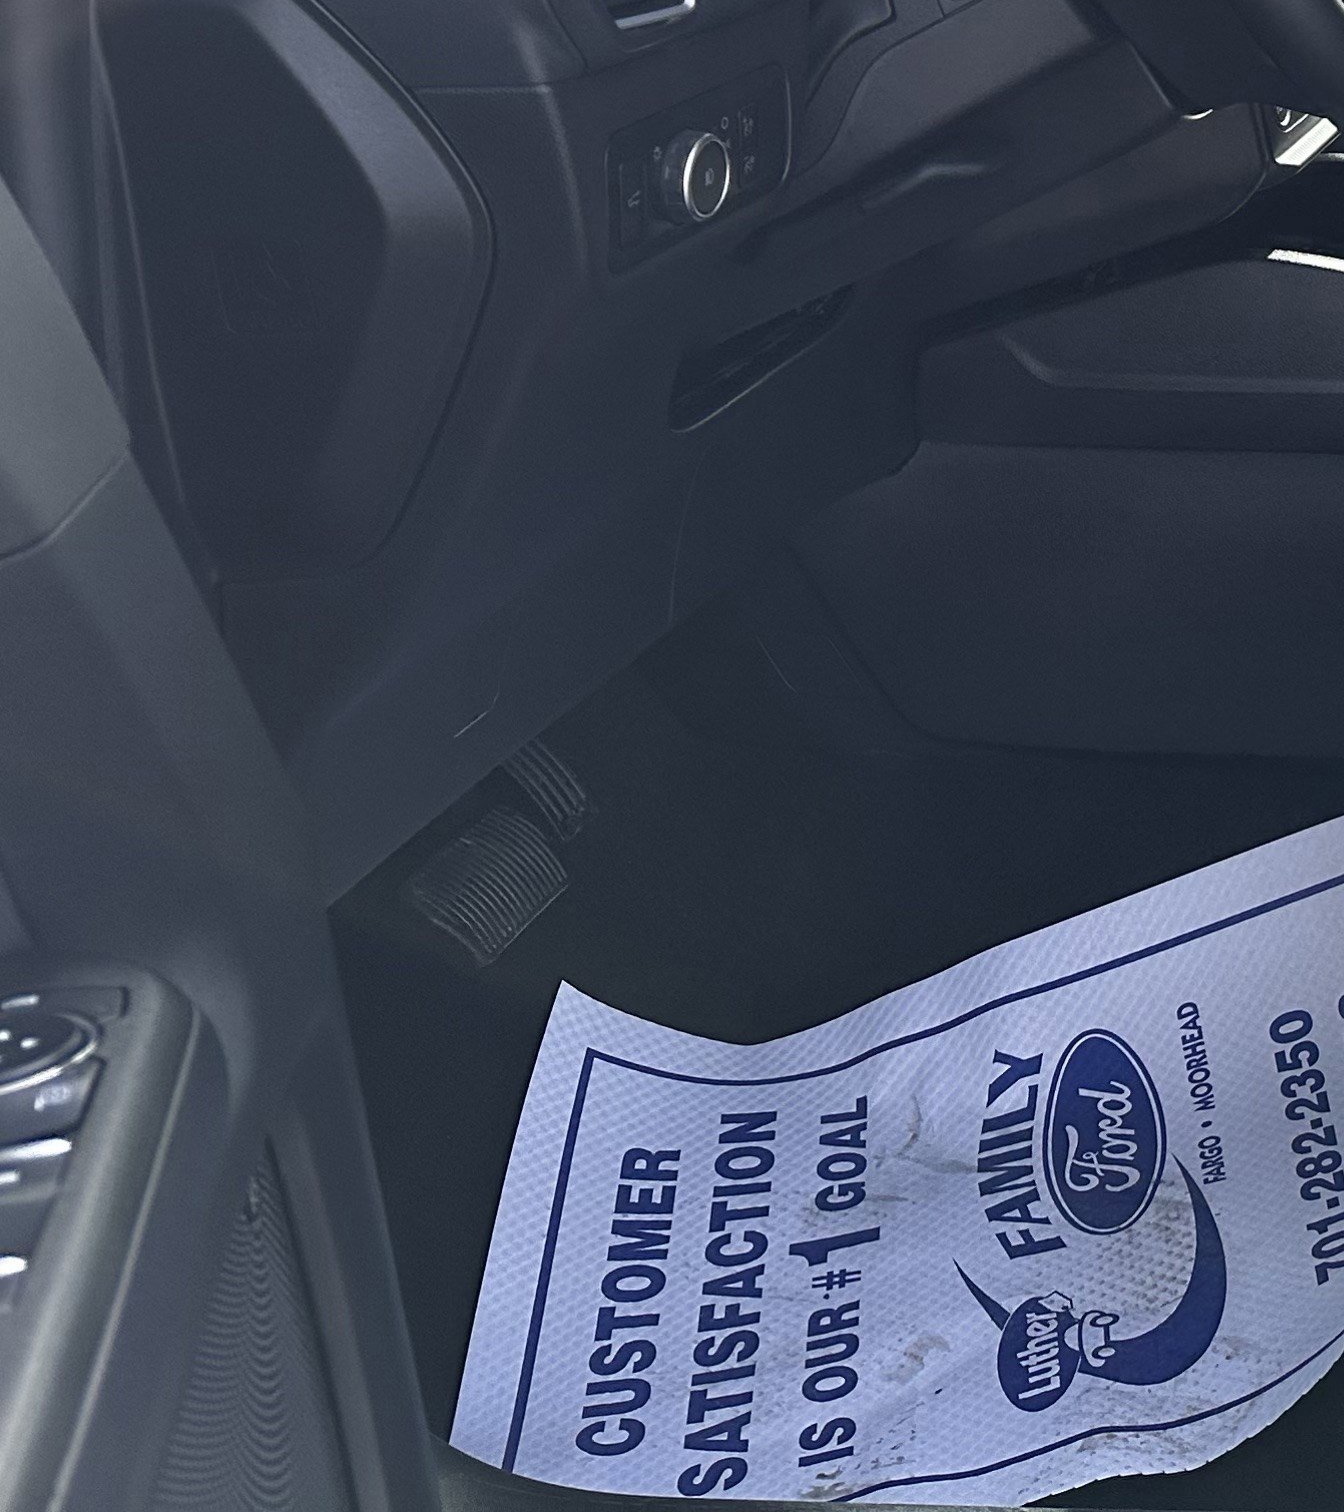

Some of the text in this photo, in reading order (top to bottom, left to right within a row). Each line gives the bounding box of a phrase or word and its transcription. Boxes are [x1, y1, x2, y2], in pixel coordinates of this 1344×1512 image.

[1063, 1080, 1141, 1193] Ford
[1176, 1001, 1227, 1185] FARGO MOORHEAD
[814, 1095, 870, 1212] GOAL
[977, 1049, 1068, 1260] FAMILY
[574, 1145, 682, 1459] CUSTOMER
[677, 1110, 778, 1497] SATISFACTION
[802, 1301, 862, 1404] OUR
[1017, 1311, 1062, 1400] Luther
[797, 1417, 856, 1469] IS
